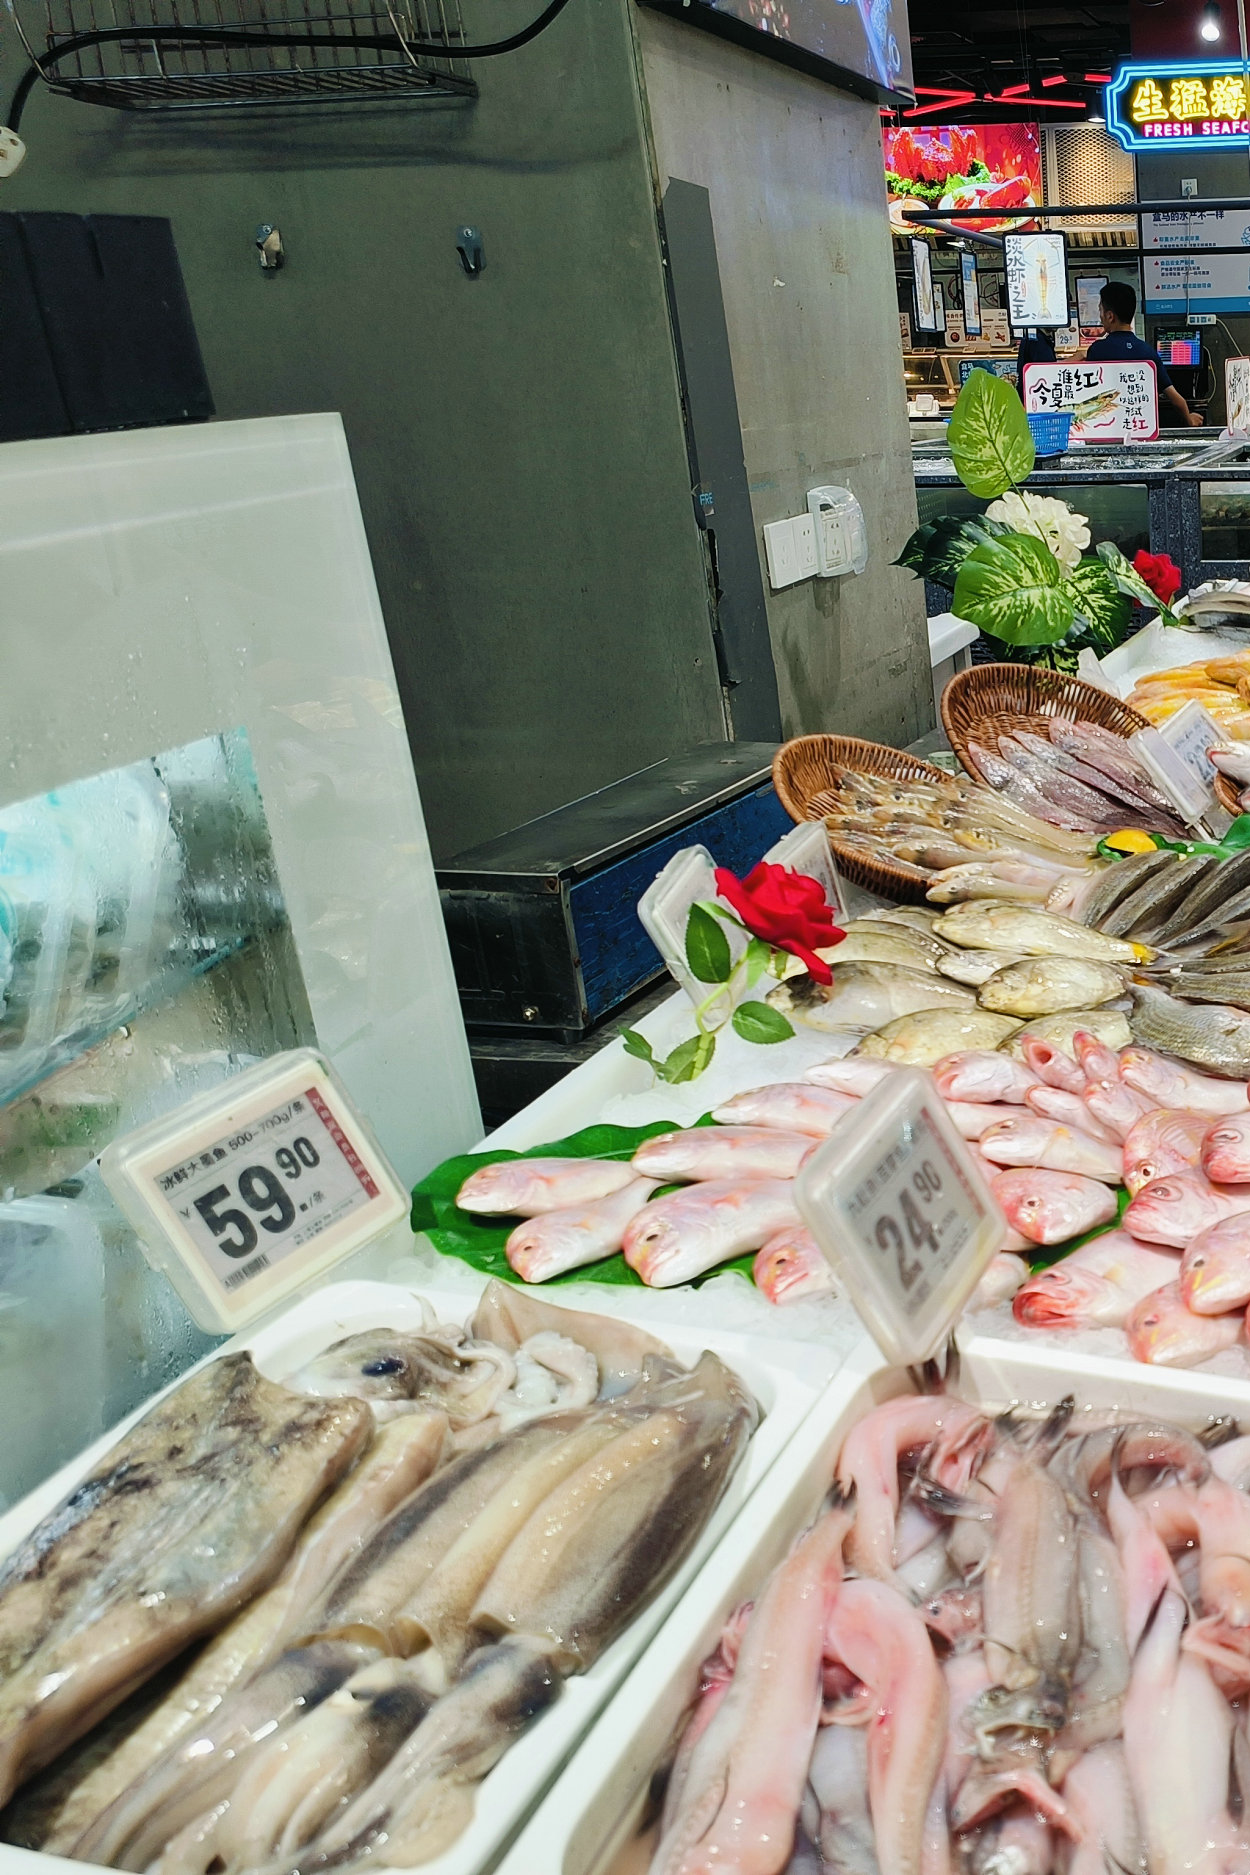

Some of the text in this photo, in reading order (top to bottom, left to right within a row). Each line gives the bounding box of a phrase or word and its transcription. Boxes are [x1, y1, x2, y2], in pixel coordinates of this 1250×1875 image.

[1144, 123, 1193, 137] FRESH
[1006, 237, 1030, 320] 淡水虾之王
[1127, 383, 1144, 395] 想到
[1125, 406, 1143, 417] 形式
[1122, 417, 1149, 431] 走红
